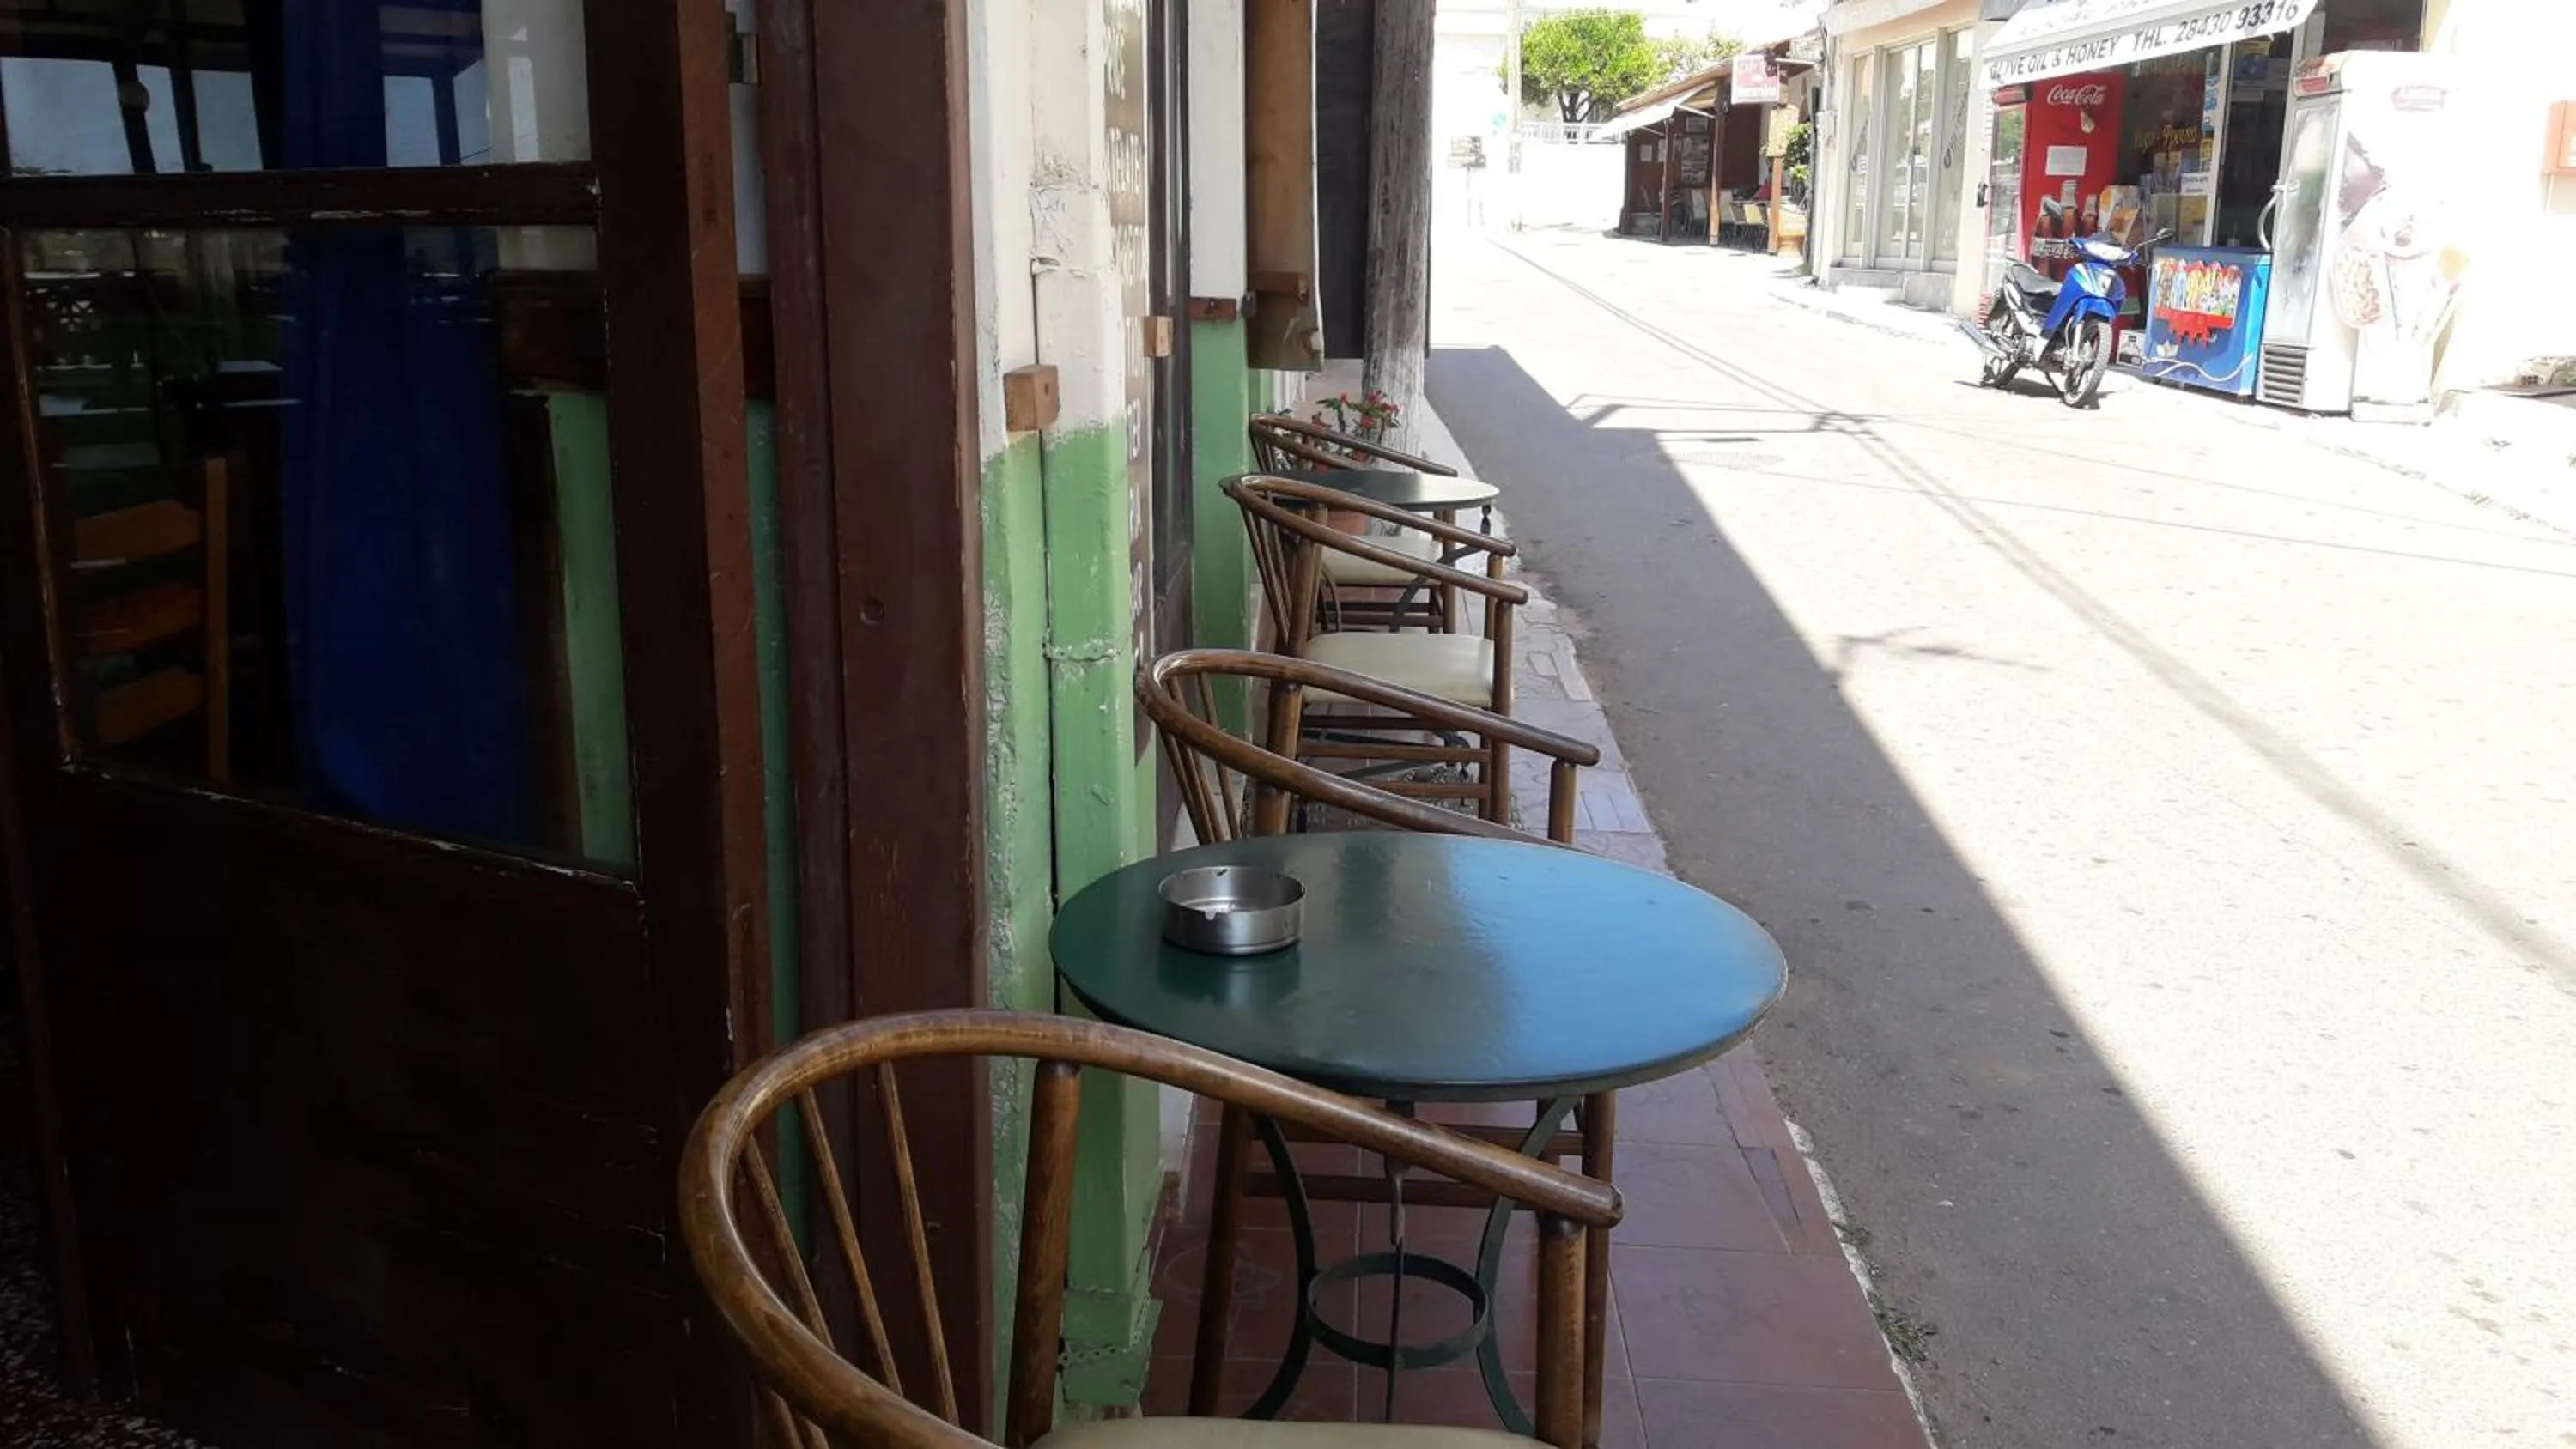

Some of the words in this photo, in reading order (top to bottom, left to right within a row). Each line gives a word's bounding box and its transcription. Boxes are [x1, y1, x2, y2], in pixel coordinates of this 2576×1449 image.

[1990, 57, 2026, 81] OLIVE
[2027, 54, 2048, 74] OIL
[2065, 37, 2120, 65] HONEY
[2174, 10, 2231, 43] 28430
[2235, 0, 2299, 30] 93316
